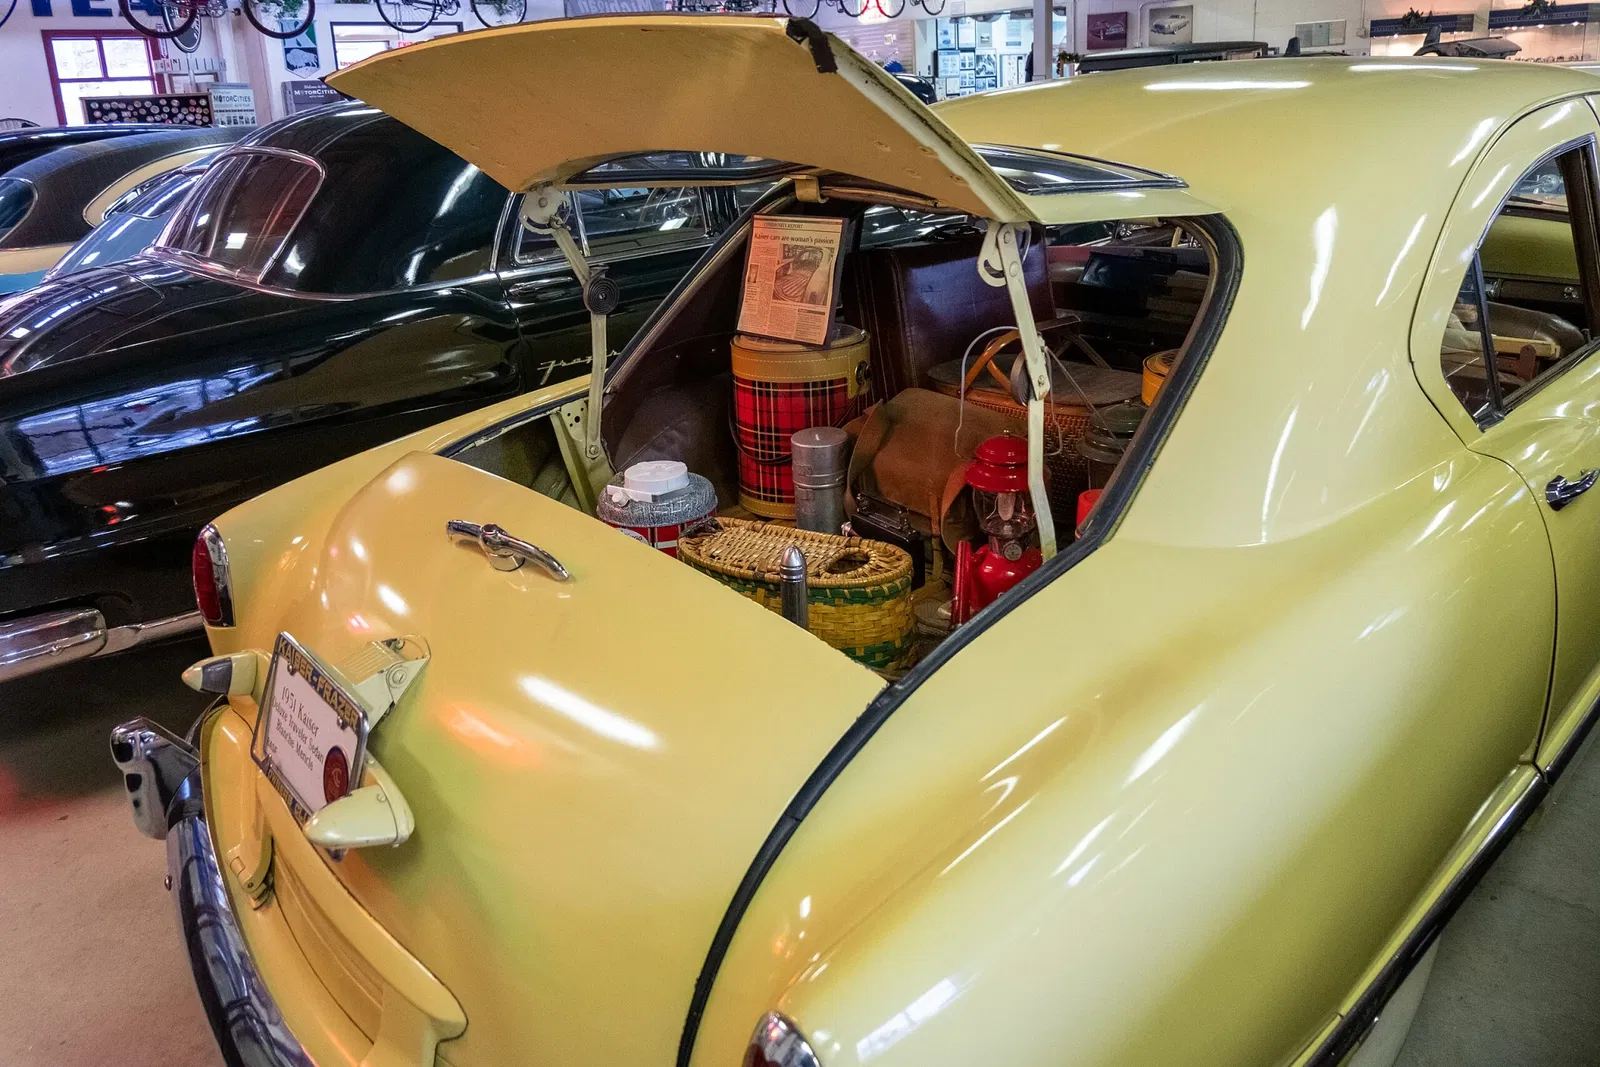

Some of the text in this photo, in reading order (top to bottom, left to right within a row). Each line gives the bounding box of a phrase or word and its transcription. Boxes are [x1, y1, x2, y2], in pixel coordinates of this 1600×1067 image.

[755, 232, 769, 240] Kaiser
[537, 350, 621, 385] Frazr
[281, 686, 320, 738] 1951 Kaiser
[288, 714, 308, 745] Traveler
[309, 738, 325, 765] Sedan
